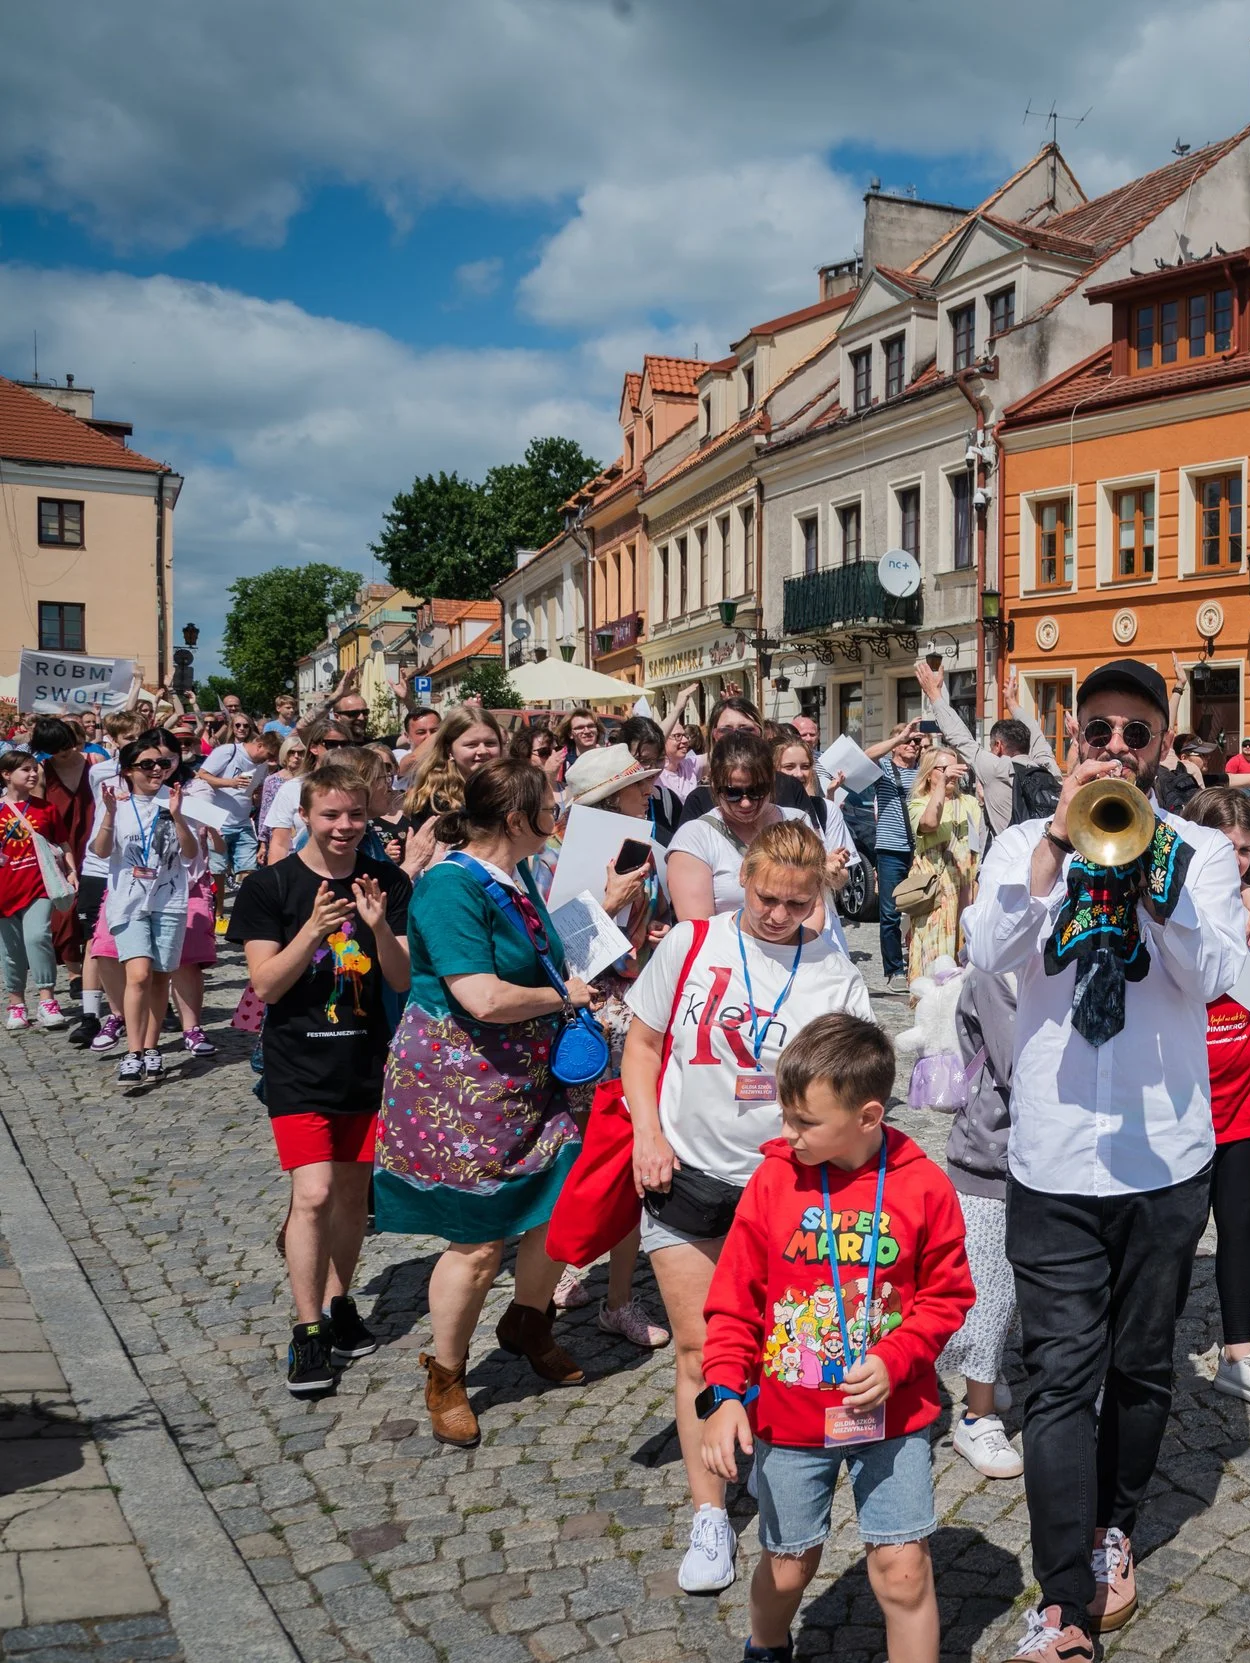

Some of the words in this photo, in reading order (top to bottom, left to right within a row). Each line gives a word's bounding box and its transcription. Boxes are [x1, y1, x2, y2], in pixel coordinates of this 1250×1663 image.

[889, 560, 909, 570] nc+
[36, 661, 113, 682] RÓBM
[418, 678, 428, 691] P
[35, 685, 114, 706] SWOJE
[801, 1206, 892, 1235] SUPER
[783, 1229, 900, 1268] MARIO
[834, 1420, 856, 1428] GILDIA
[857, 1416, 876, 1425] SZKÓŁ
